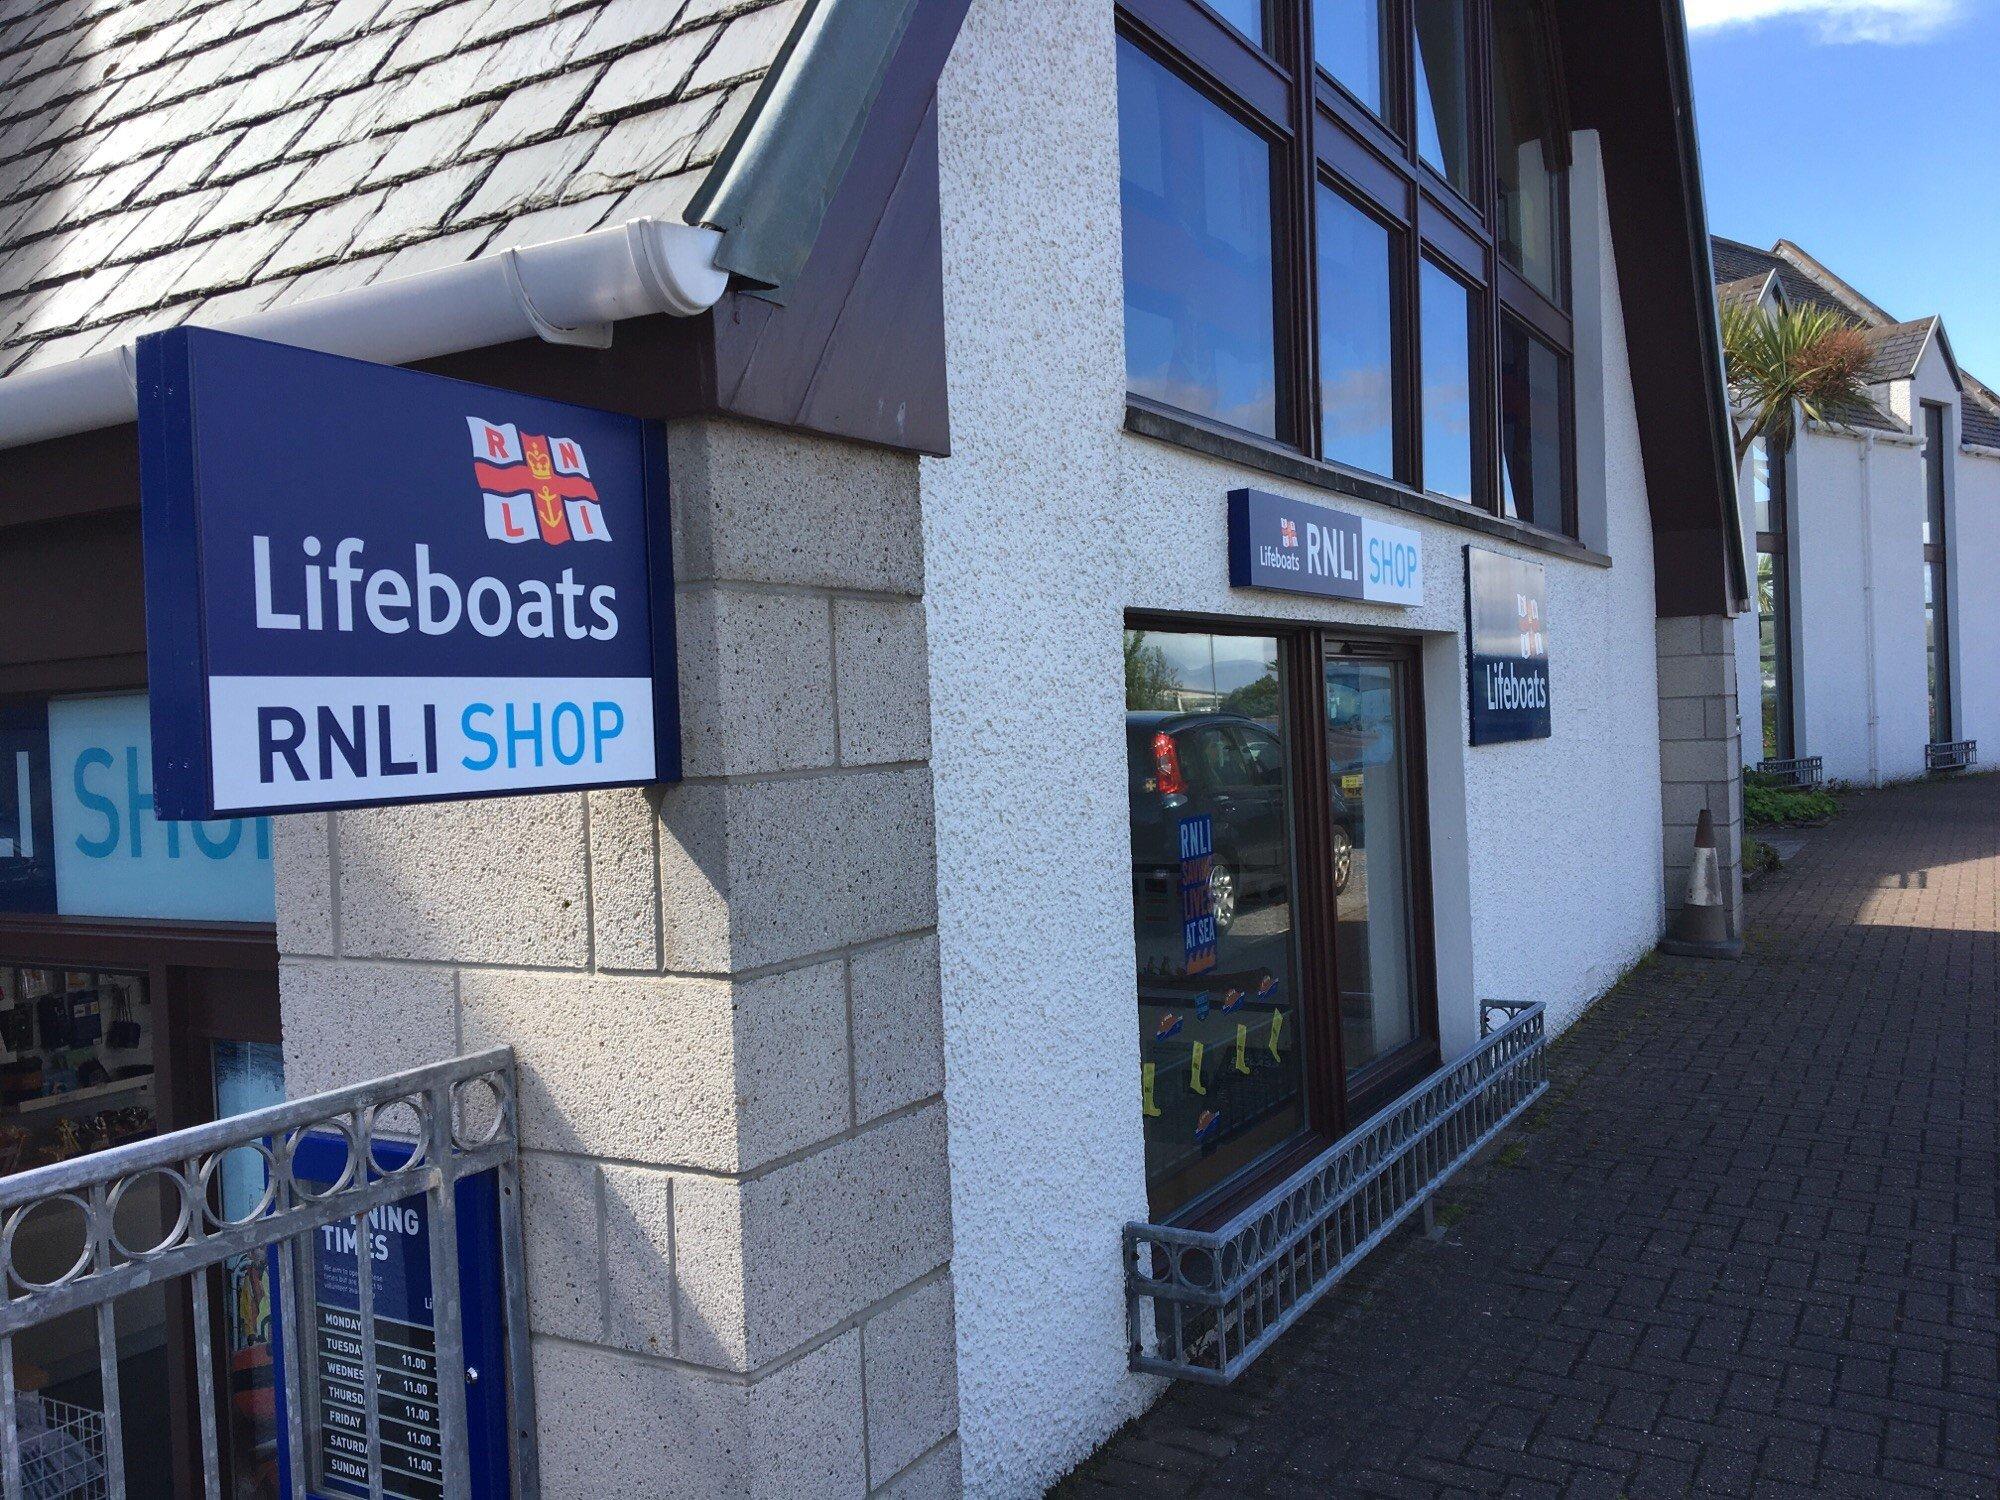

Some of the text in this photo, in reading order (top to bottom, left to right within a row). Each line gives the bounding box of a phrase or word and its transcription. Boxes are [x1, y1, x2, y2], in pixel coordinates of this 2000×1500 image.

[1260, 545, 1300, 571] Lifeboats
[1306, 522, 1359, 581] RNLI
[1369, 537, 1417, 588] SHOP
[252, 535, 618, 641] Lifeboats
[1486, 661, 1546, 710] Lifeboats
[257, 701, 625, 784] RNLI SHOP
[1180, 819, 1212, 859] RNLI
[1186, 916, 1215, 950] AT SEA
[335, 1204, 420, 1236] NING
[325, 1313, 361, 1331] MONDAY
[326, 1338, 427, 1370] TUESDA 11.00
[327, 1361, 428, 1396] WEDNESY 11.00
[329, 1410, 431, 1447] FRIDAY 11.00
[405, 1405, 430, 1421] 11.00
[331, 1459, 366, 1478] SUNDAY
[407, 1456, 432, 1472] 11.00
